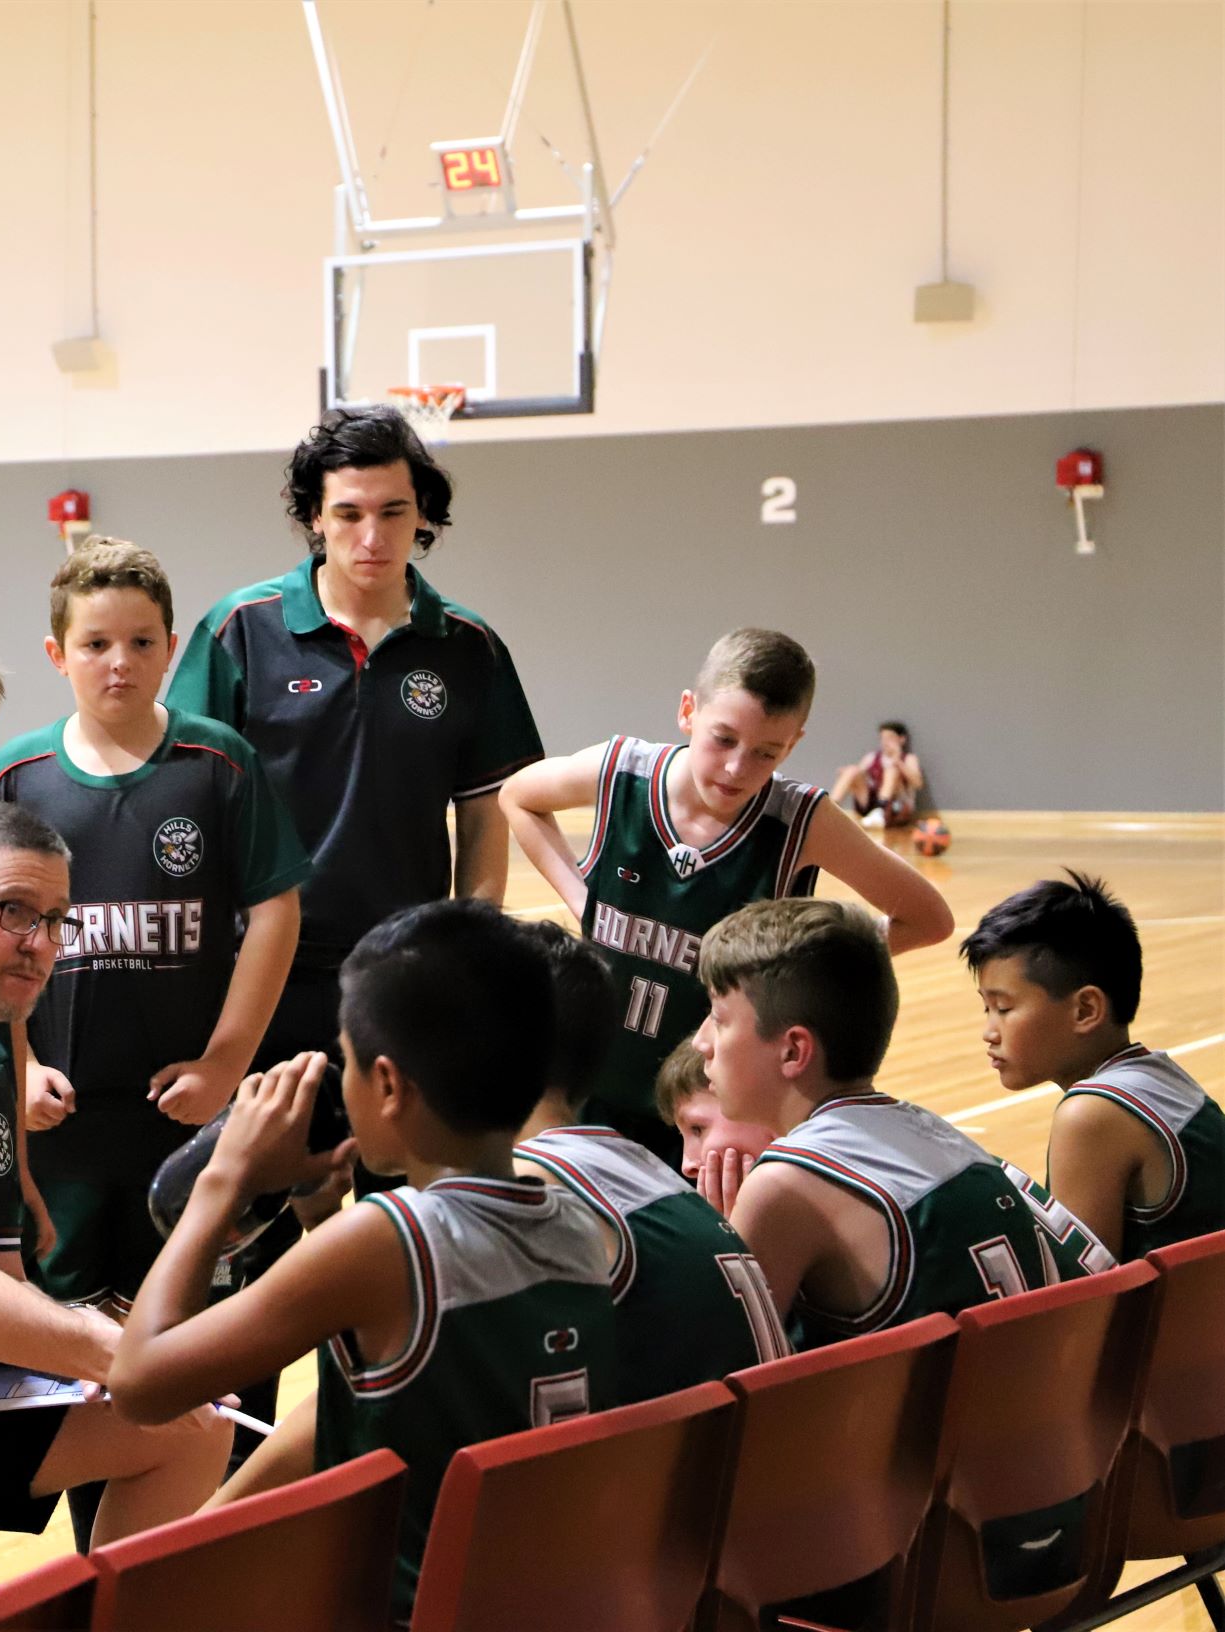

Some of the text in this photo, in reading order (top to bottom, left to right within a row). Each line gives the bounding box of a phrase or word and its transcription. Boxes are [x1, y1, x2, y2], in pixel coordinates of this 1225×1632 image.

[443, 150, 499, 188] 24
[761, 476, 797, 524] 2
[412, 673, 439, 686] HILLS
[407, 697, 443, 716] HORNETS
[163, 821, 193, 835] HILLS
[159, 853, 200, 873] HORNETS
[55, 898, 204, 961] ORNETS
[592, 901, 703, 974] HORNE
[92, 959, 153, 971] BASKETBALL
[624, 976, 669, 1038] 11
